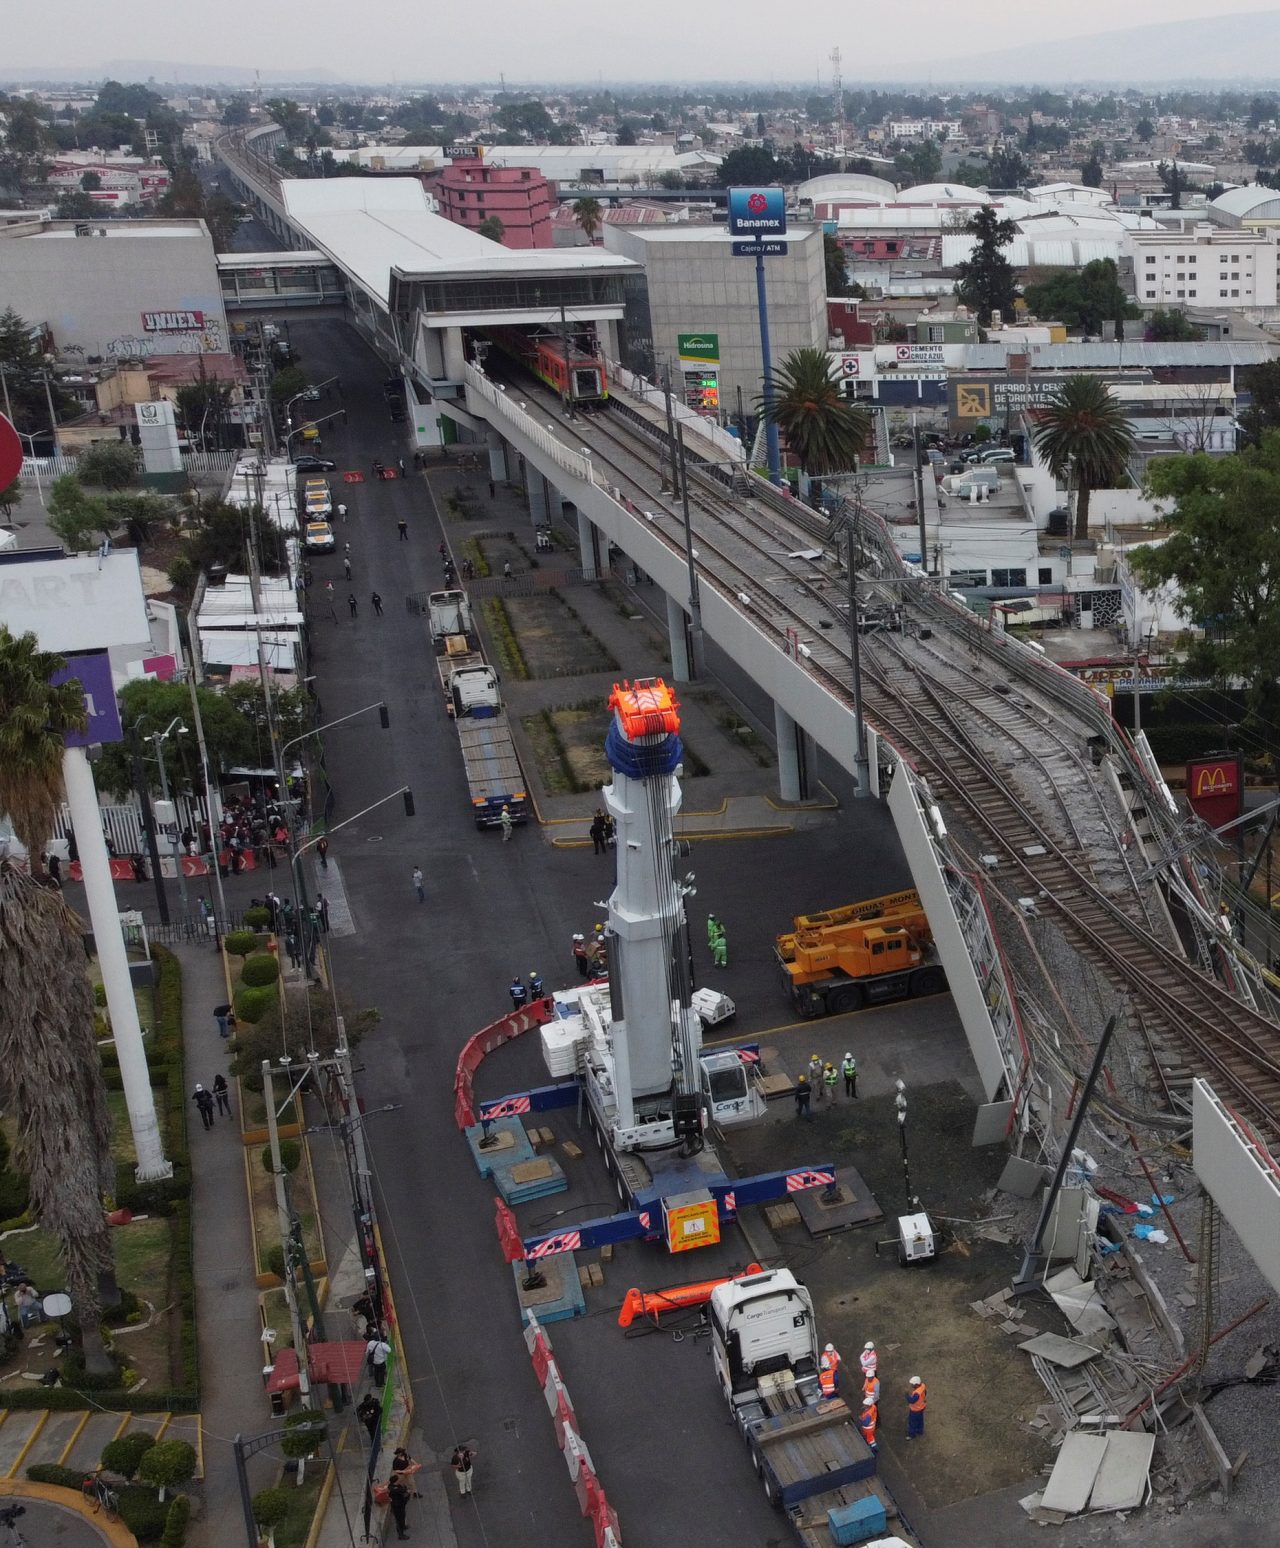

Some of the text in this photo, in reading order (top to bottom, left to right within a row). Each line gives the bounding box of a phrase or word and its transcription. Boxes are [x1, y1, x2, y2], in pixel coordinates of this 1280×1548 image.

[446, 147, 476, 155] HOTEL
[736, 218, 780, 228] Banamex
[740, 245, 760, 253] Cajero
[1034, 384, 1041, 395] Y
[995, 394, 1007, 403] DE
[1079, 669, 1133, 681] LICEO
[716, 1101, 745, 1112] Cargo
[796, 1316, 804, 1326] 3
